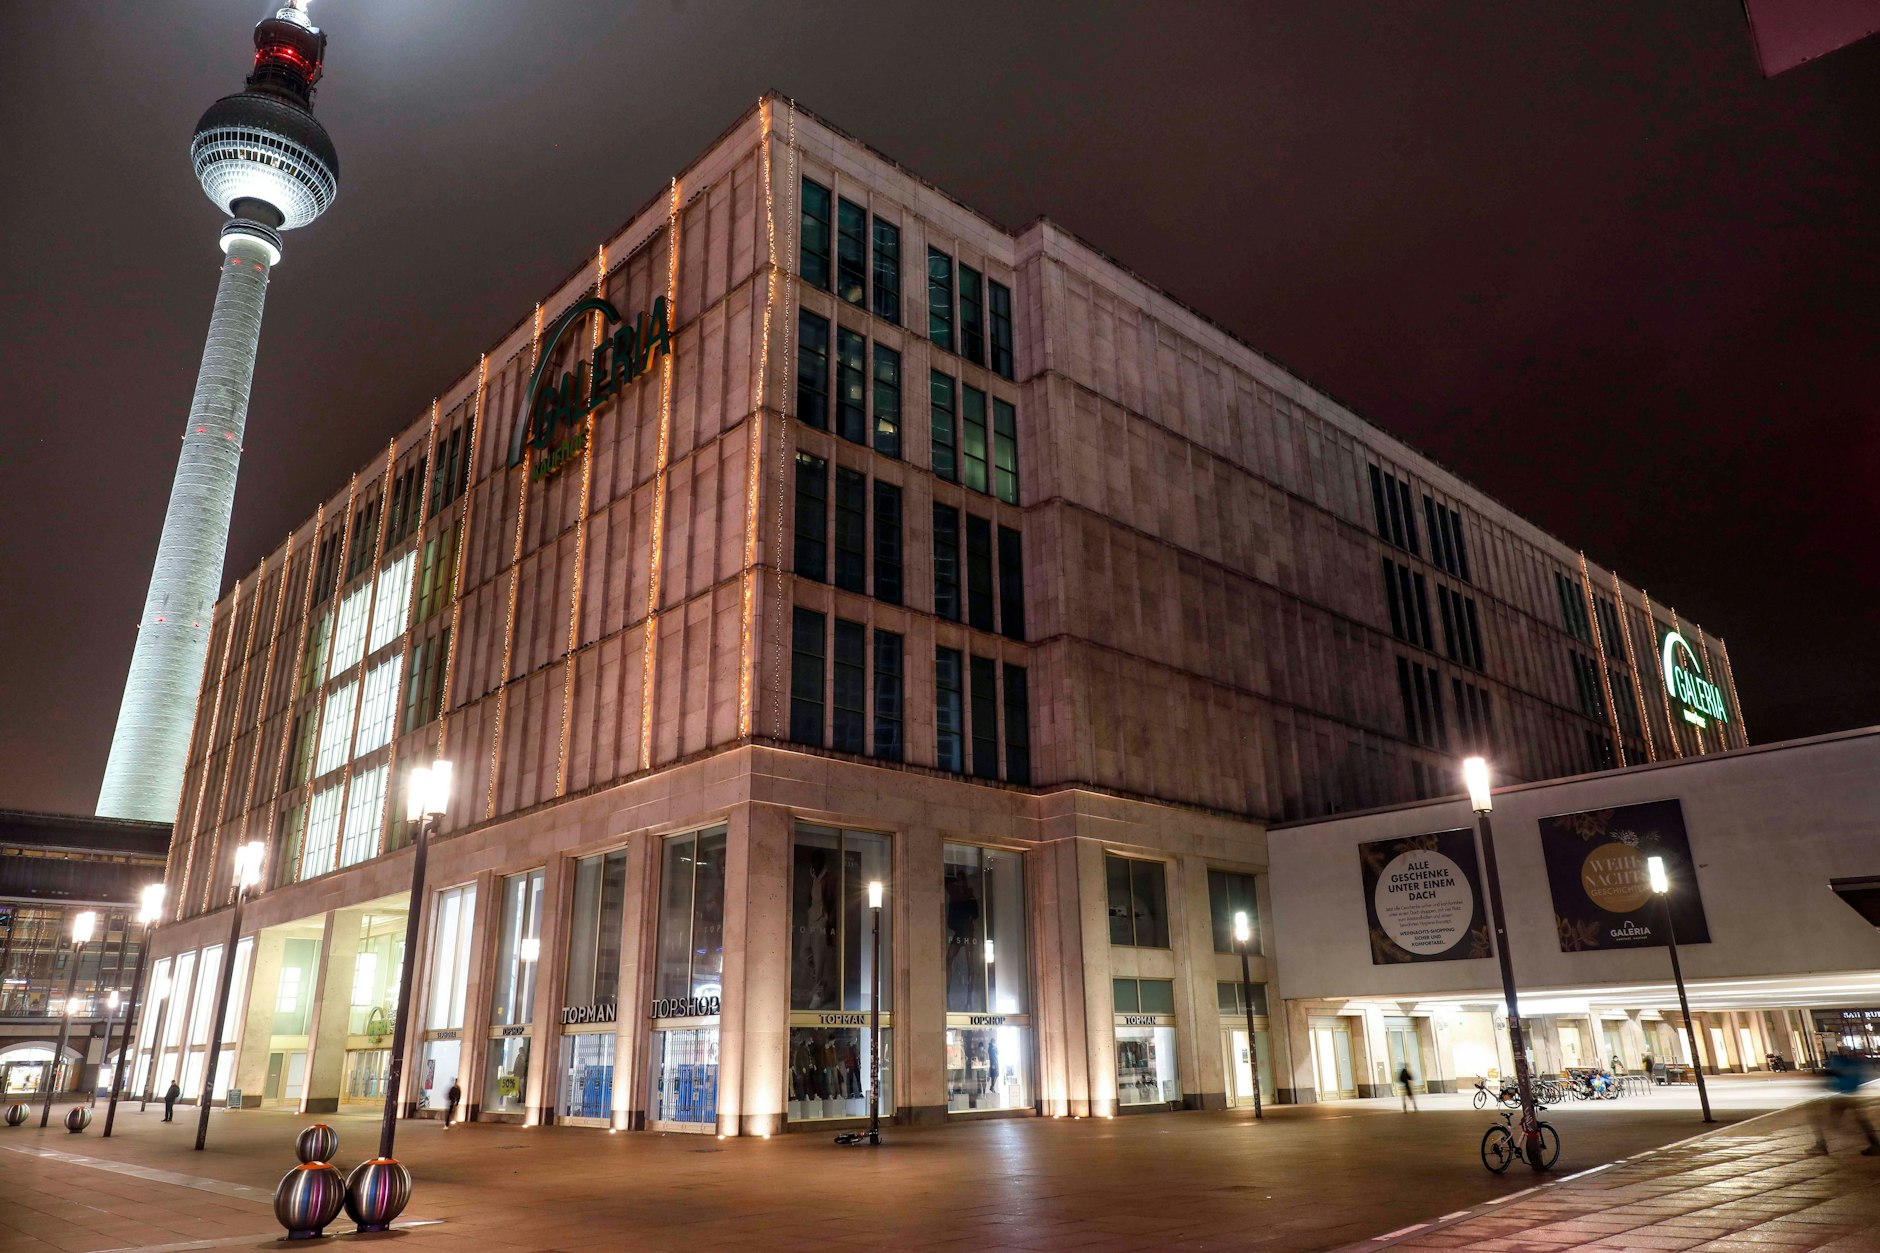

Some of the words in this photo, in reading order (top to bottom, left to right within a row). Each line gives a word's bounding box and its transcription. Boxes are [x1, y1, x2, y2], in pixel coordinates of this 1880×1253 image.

[534, 295, 670, 449] GALERIA
[1674, 665, 1728, 724] GALERIA
[1408, 861, 1429, 872] ALLE
[1391, 868, 1449, 883] GESCHENKE
[1388, 881, 1420, 893] UNTER
[1423, 878, 1455, 889] EINEM
[1409, 890, 1436, 901] DACH
[1610, 927, 1651, 938] GALERIA
[652, 996, 720, 1019] TOPSHOP
[562, 1004, 617, 1024] TOPMAN
[820, 1014, 865, 1025] TOPMAN
[970, 1016, 1006, 1026] TOPSHOP
[1125, 1016, 1156, 1025] TOPMAN
[502, 1078, 515, 1089] 50%
